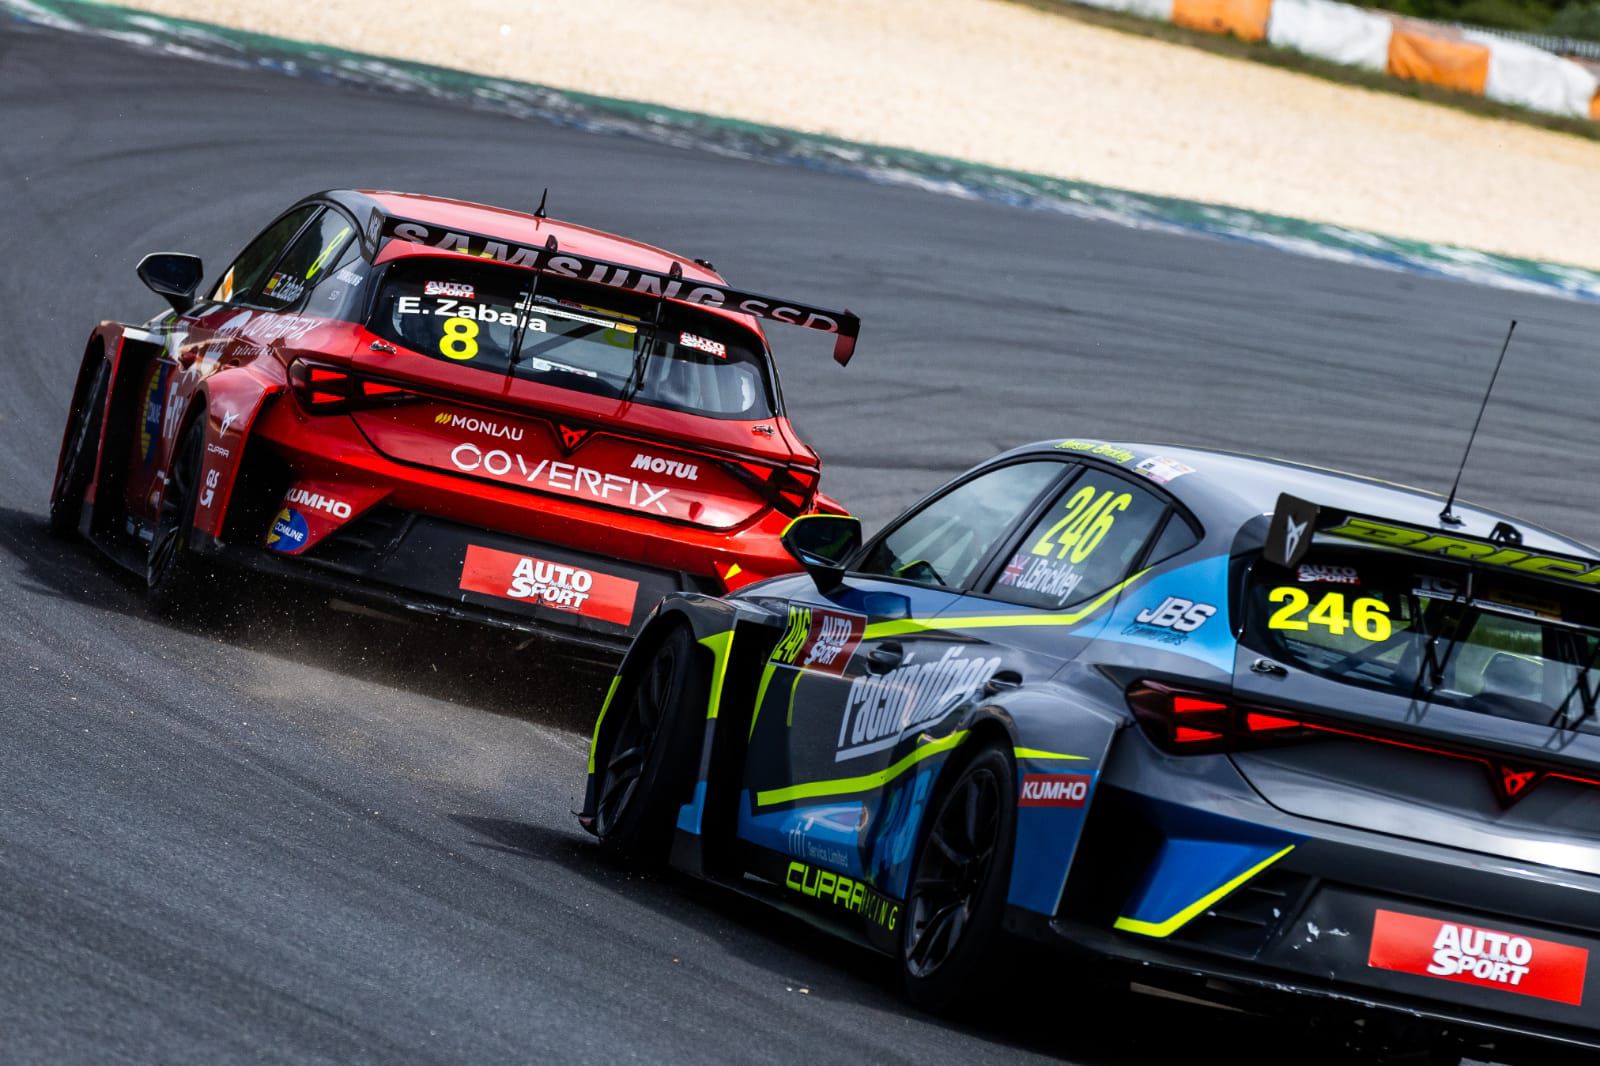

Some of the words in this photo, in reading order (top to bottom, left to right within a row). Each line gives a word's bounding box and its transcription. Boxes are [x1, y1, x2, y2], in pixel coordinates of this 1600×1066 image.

[394, 222, 726, 308] SAMSUNG
[738, 299, 839, 334] SSD
[424, 287, 475, 299] SPORT
[425, 280, 475, 292] AUTO
[439, 316, 479, 360] 8
[680, 338, 727, 357] SPORT
[682, 330, 726, 349] AUTO
[451, 413, 524, 442] MONLAU
[451, 442, 670, 513] COVERFIX
[630, 453, 699, 481] MOTUL
[1031, 486, 1133, 564] 246
[1320, 516, 1600, 585] BRIC
[511, 557, 593, 593] AUTO
[1298, 572, 1360, 584] SPORT
[1299, 564, 1358, 577] AUTO
[506, 577, 590, 609] SPORT
[817, 615, 853, 648] AUTO
[1135, 595, 1218, 633] JBS
[1268, 586, 1392, 643] 246
[772, 605, 812, 664] 246
[804, 640, 843, 665] SPORT
[837, 645, 1003, 749] racingline
[1021, 780, 1088, 801] KUMHO
[785, 861, 865, 913] CUPRA
[1432, 923, 1533, 967] AUTO
[1426, 948, 1531, 987] SPORT
